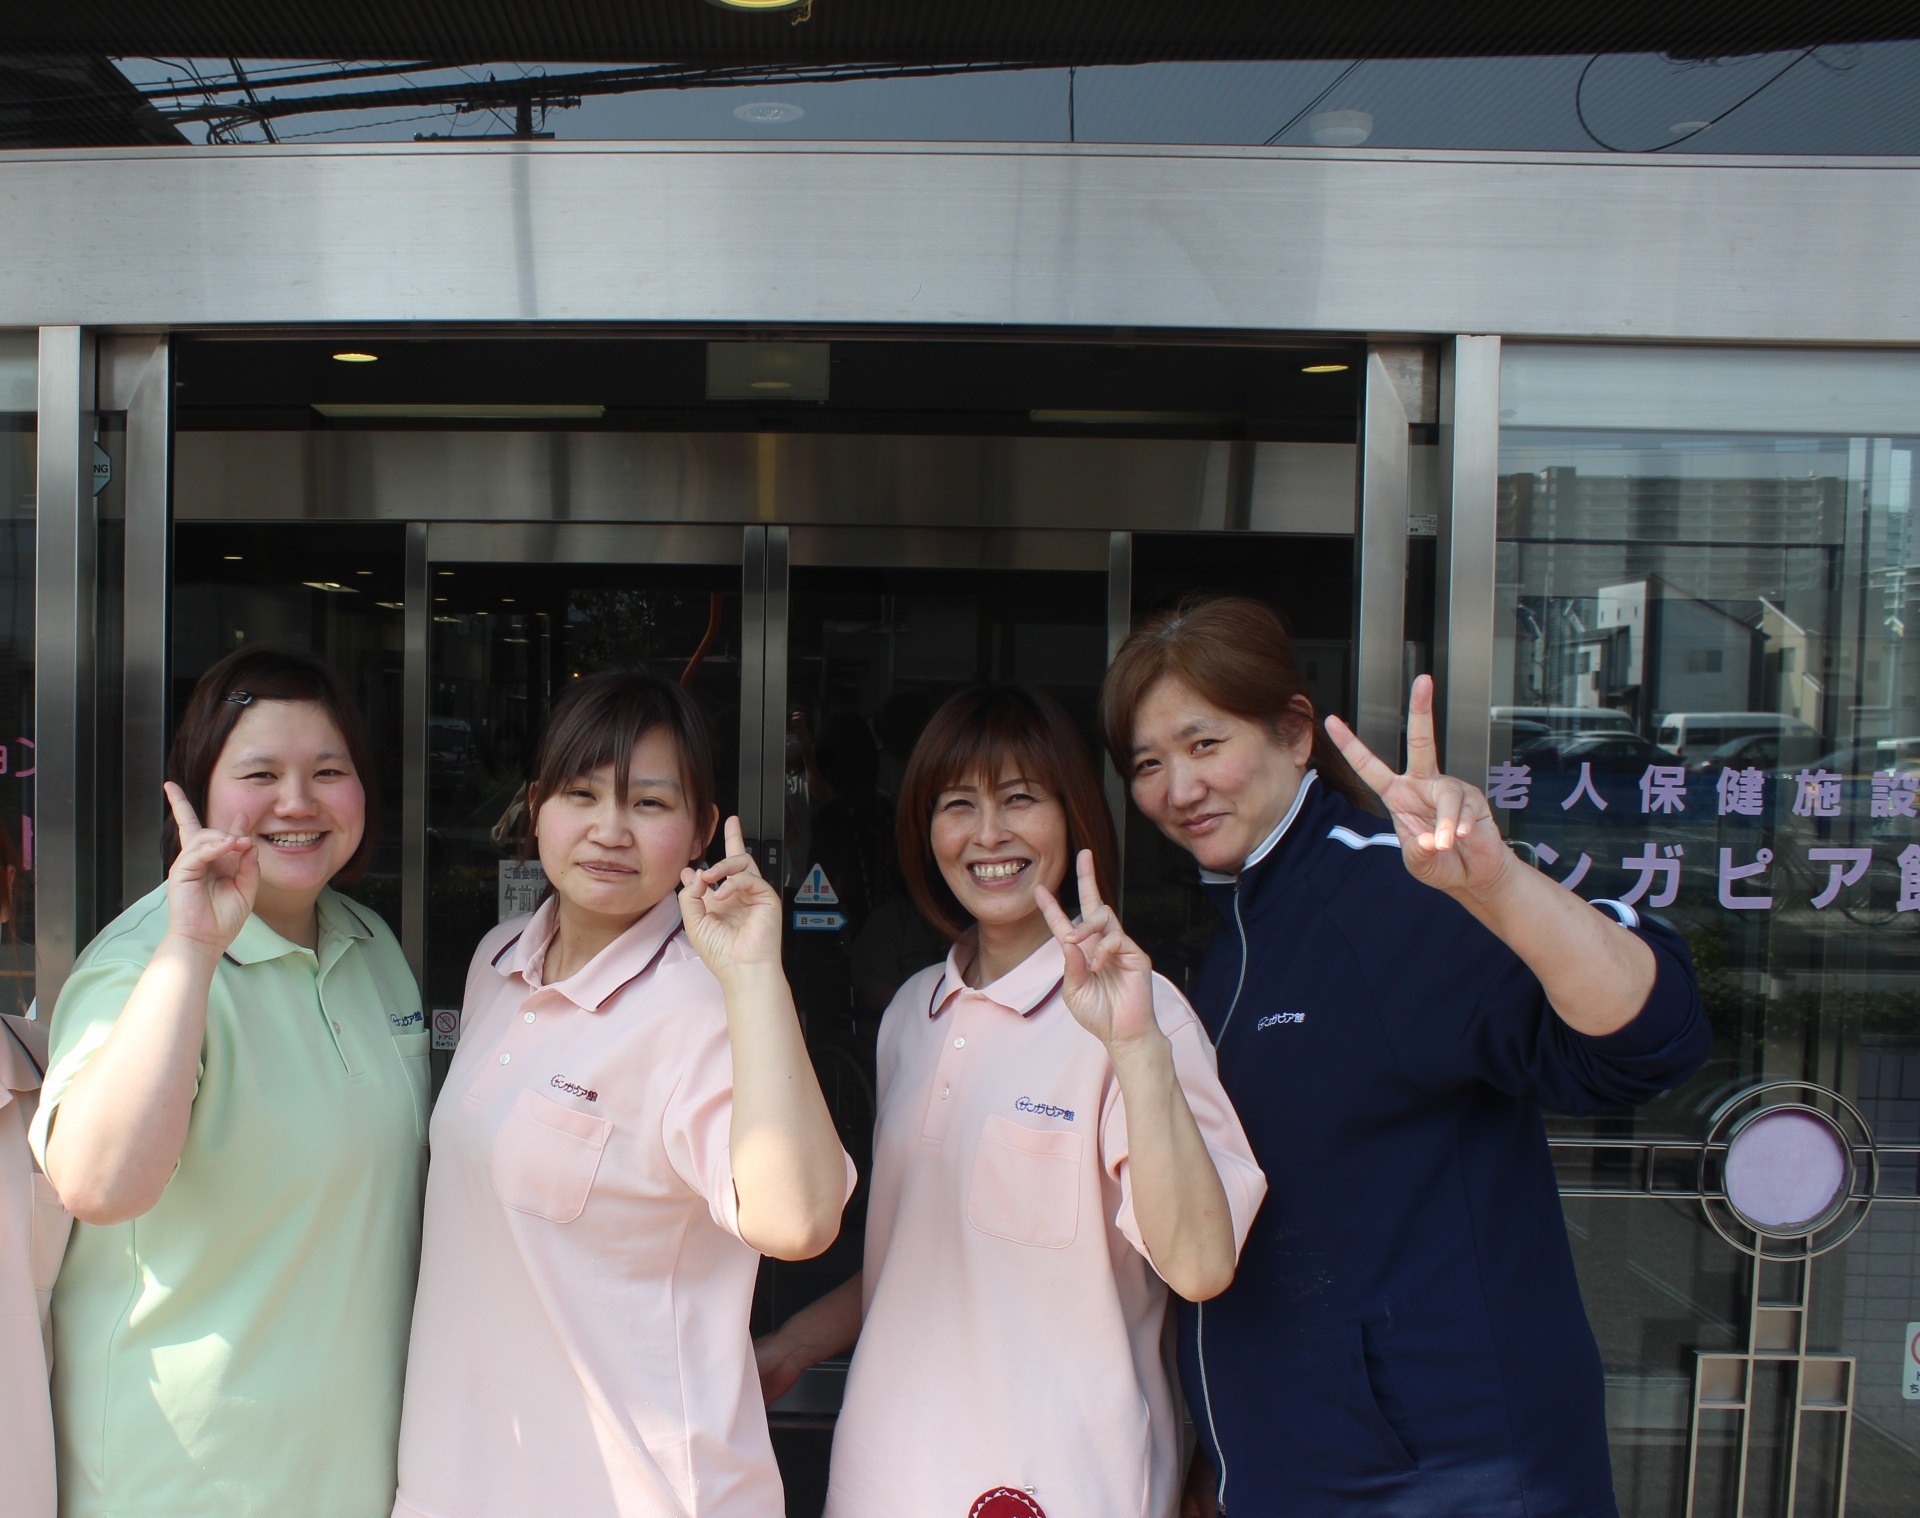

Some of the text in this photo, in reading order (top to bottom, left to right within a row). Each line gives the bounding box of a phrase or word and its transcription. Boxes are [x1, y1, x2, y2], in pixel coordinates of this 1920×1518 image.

[1487, 761, 1918, 818] 老人保健施設
[504, 883, 544, 912] 午前1
